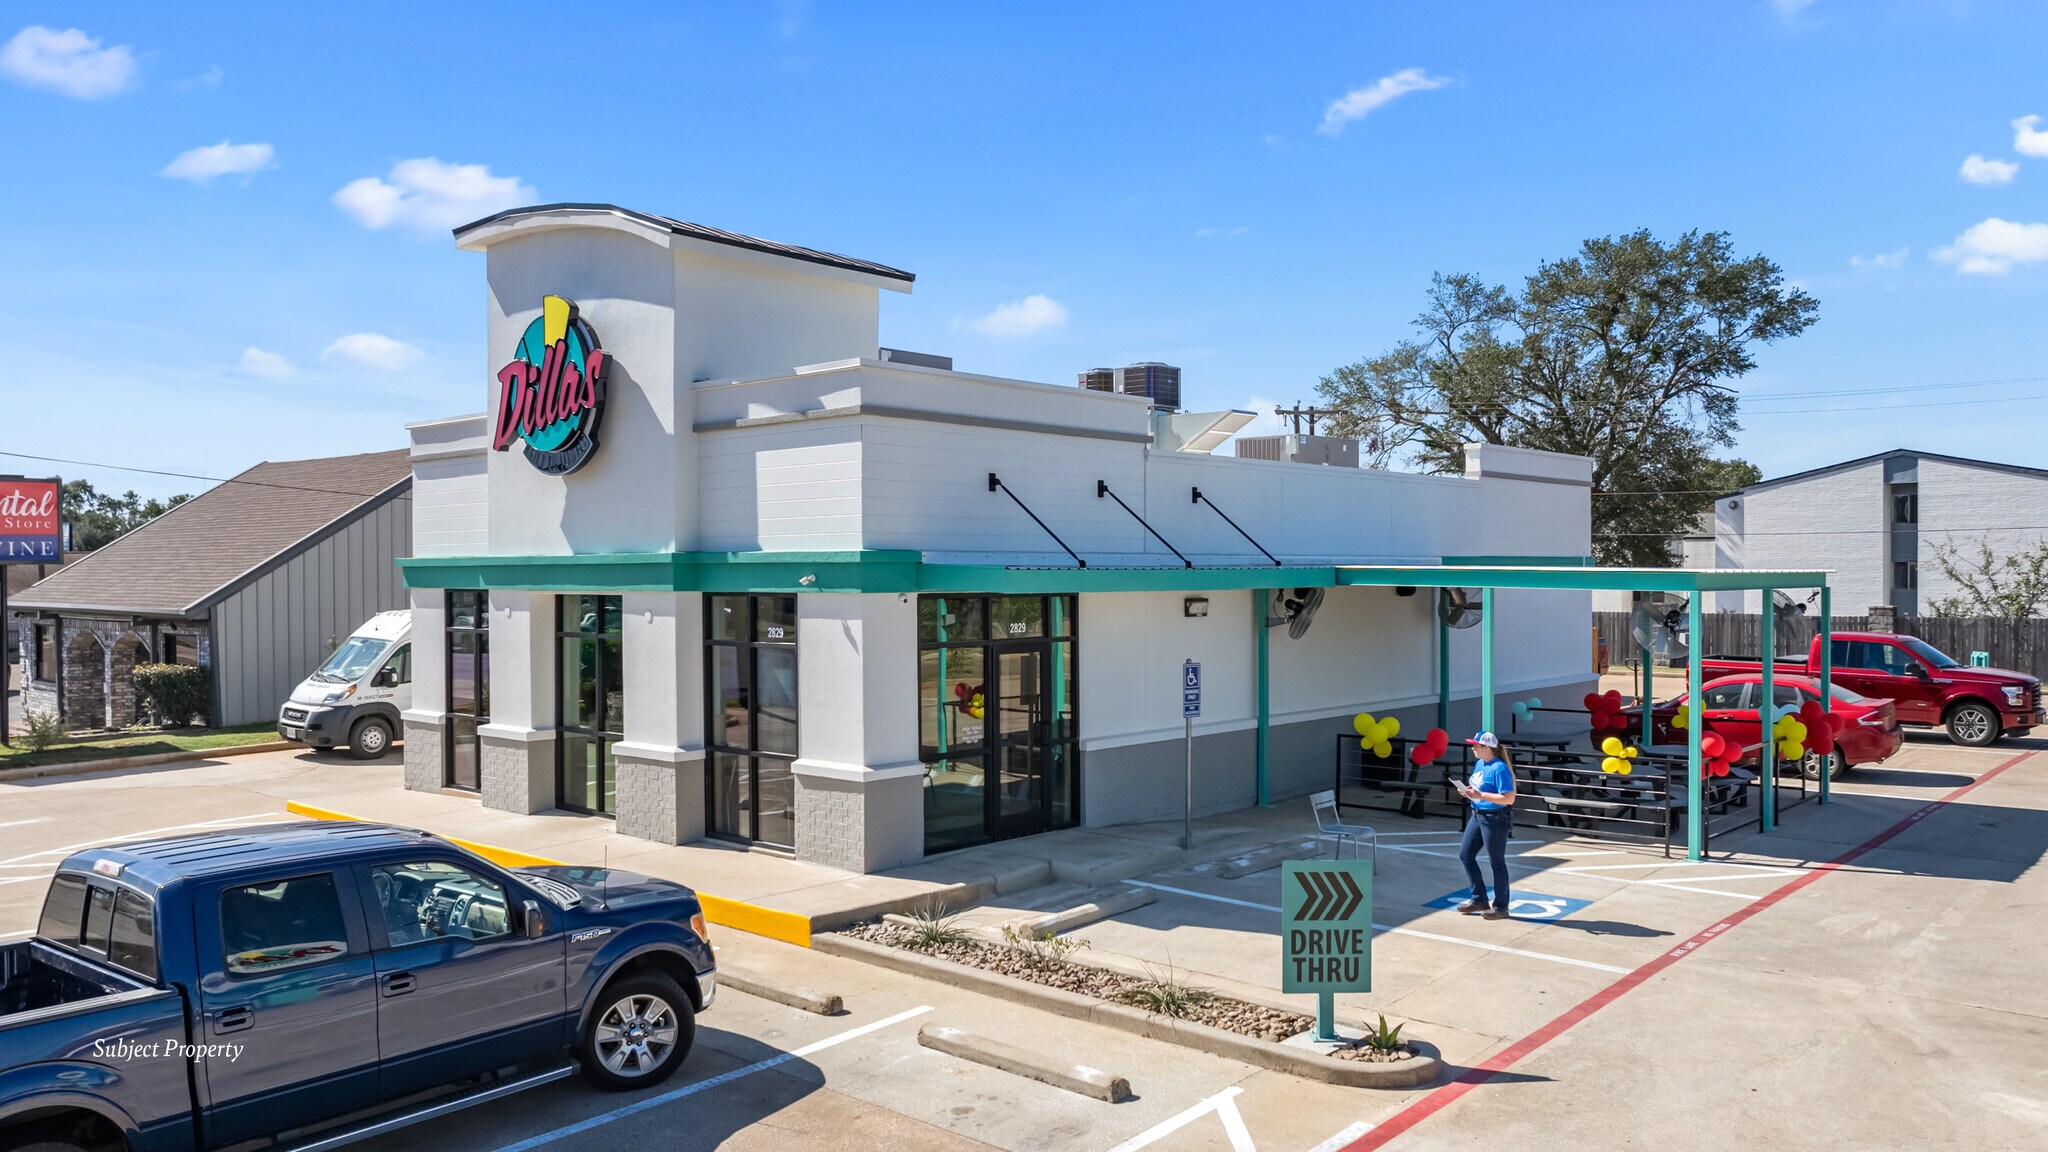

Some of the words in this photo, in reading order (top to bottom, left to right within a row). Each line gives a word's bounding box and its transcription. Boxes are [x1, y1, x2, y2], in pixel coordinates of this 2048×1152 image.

[493, 338, 604, 453] Dillas
[5, 517, 52, 529] Store
[0, 541, 54, 556] INE
[767, 627, 784, 638] 2829
[1010, 622, 1026, 633] 2829
[1291, 929, 1363, 955] DRIVE
[1292, 957, 1359, 983] THRU
